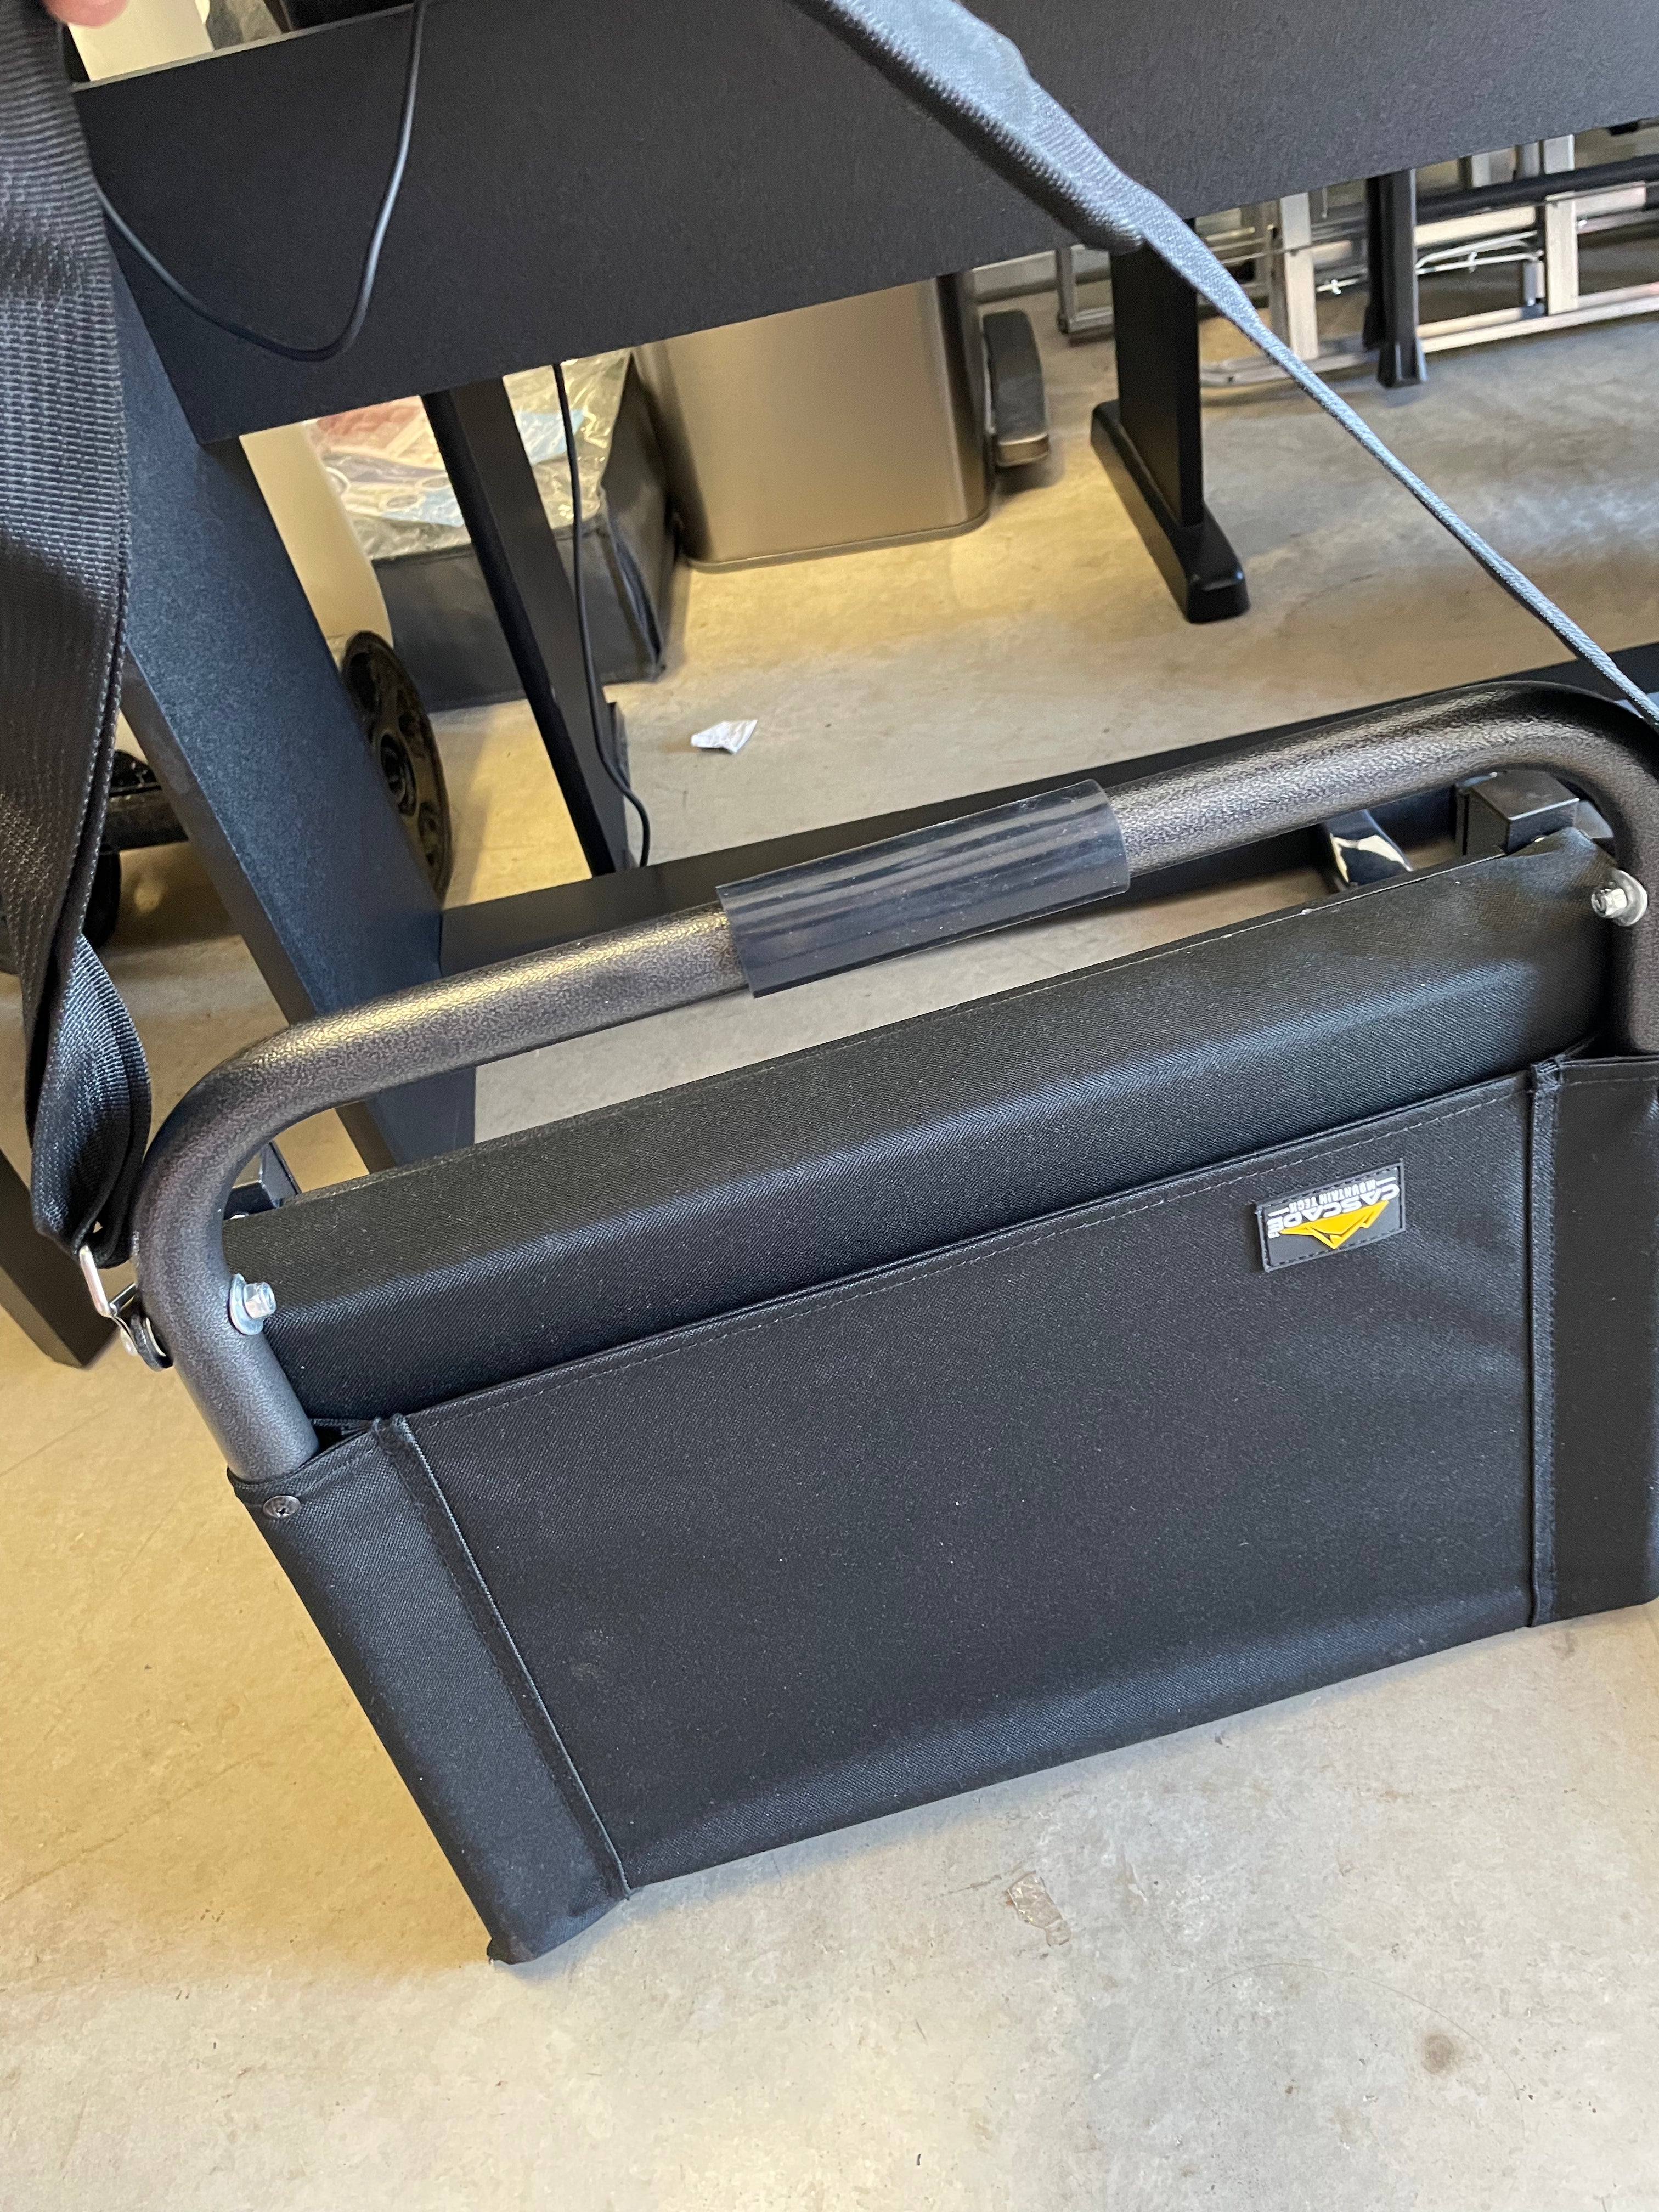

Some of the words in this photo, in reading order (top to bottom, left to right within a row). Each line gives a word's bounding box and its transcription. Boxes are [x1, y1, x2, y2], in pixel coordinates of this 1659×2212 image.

[1319, 1180, 1376, 1205] MOUNTAIN
[1267, 1184, 1400, 1230] CASCADE
[1289, 1198, 1318, 1214] TECH
